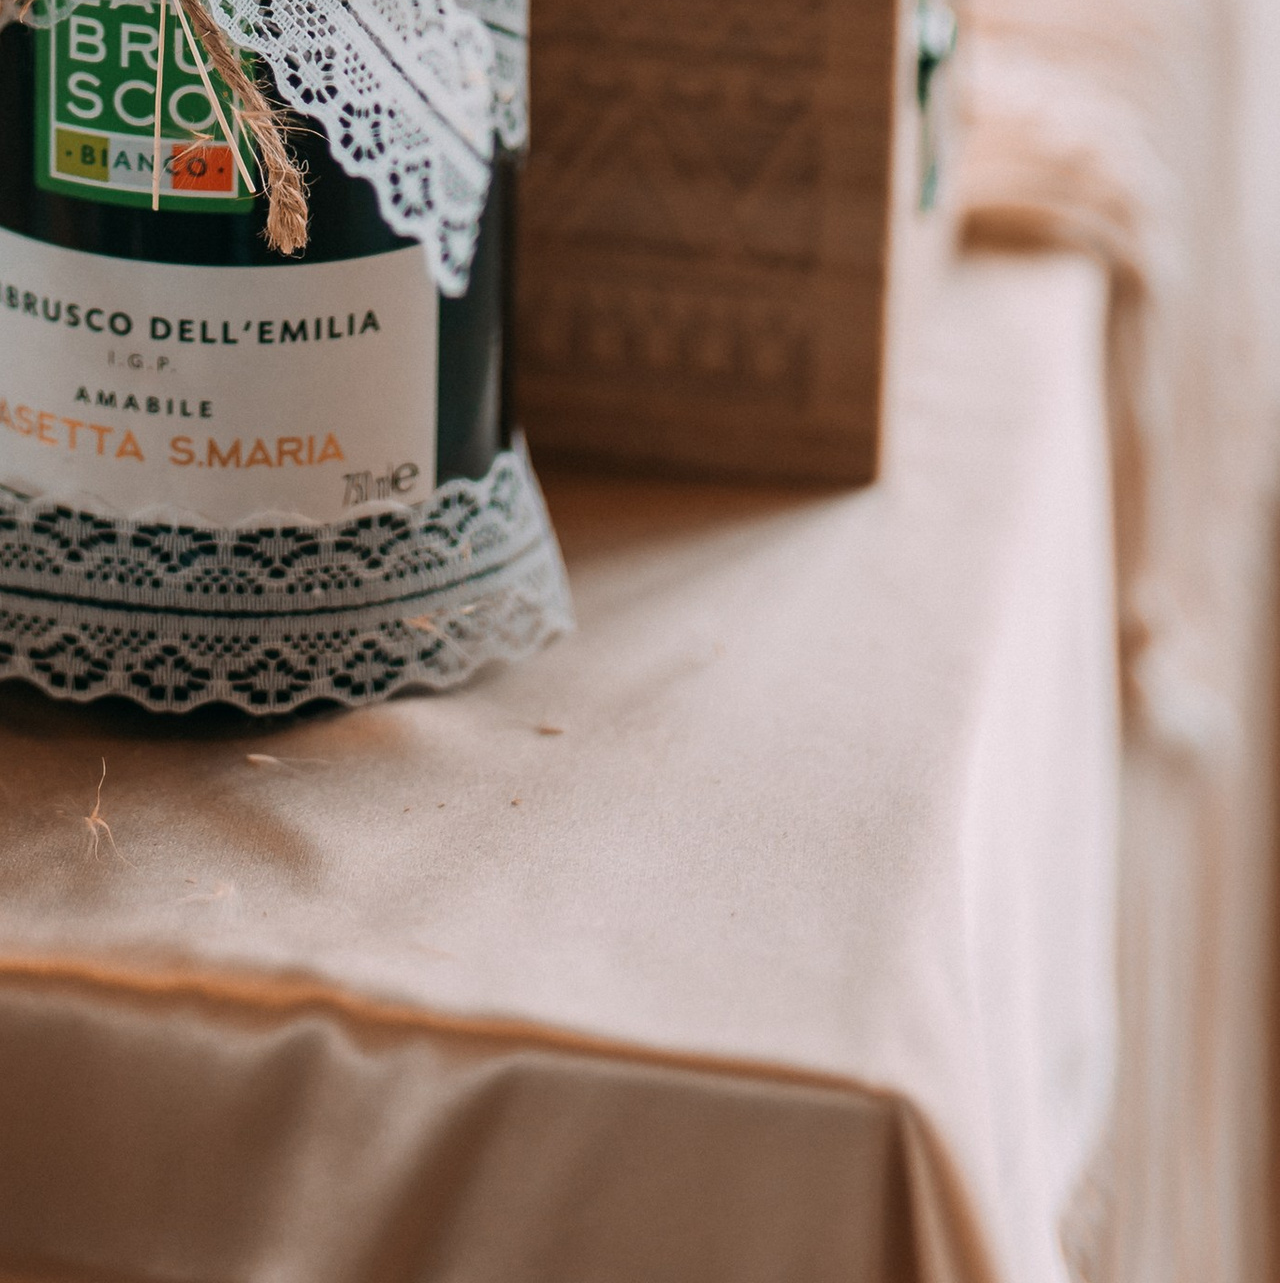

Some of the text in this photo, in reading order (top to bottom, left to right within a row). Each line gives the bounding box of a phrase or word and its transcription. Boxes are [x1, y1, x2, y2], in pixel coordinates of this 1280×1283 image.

[67, 71, 219, 131] SCO
[149, 308, 382, 346] DELL'EMILIA
[74, 385, 214, 419] AMABILE
[169, 432, 345, 469] S.MARIA
